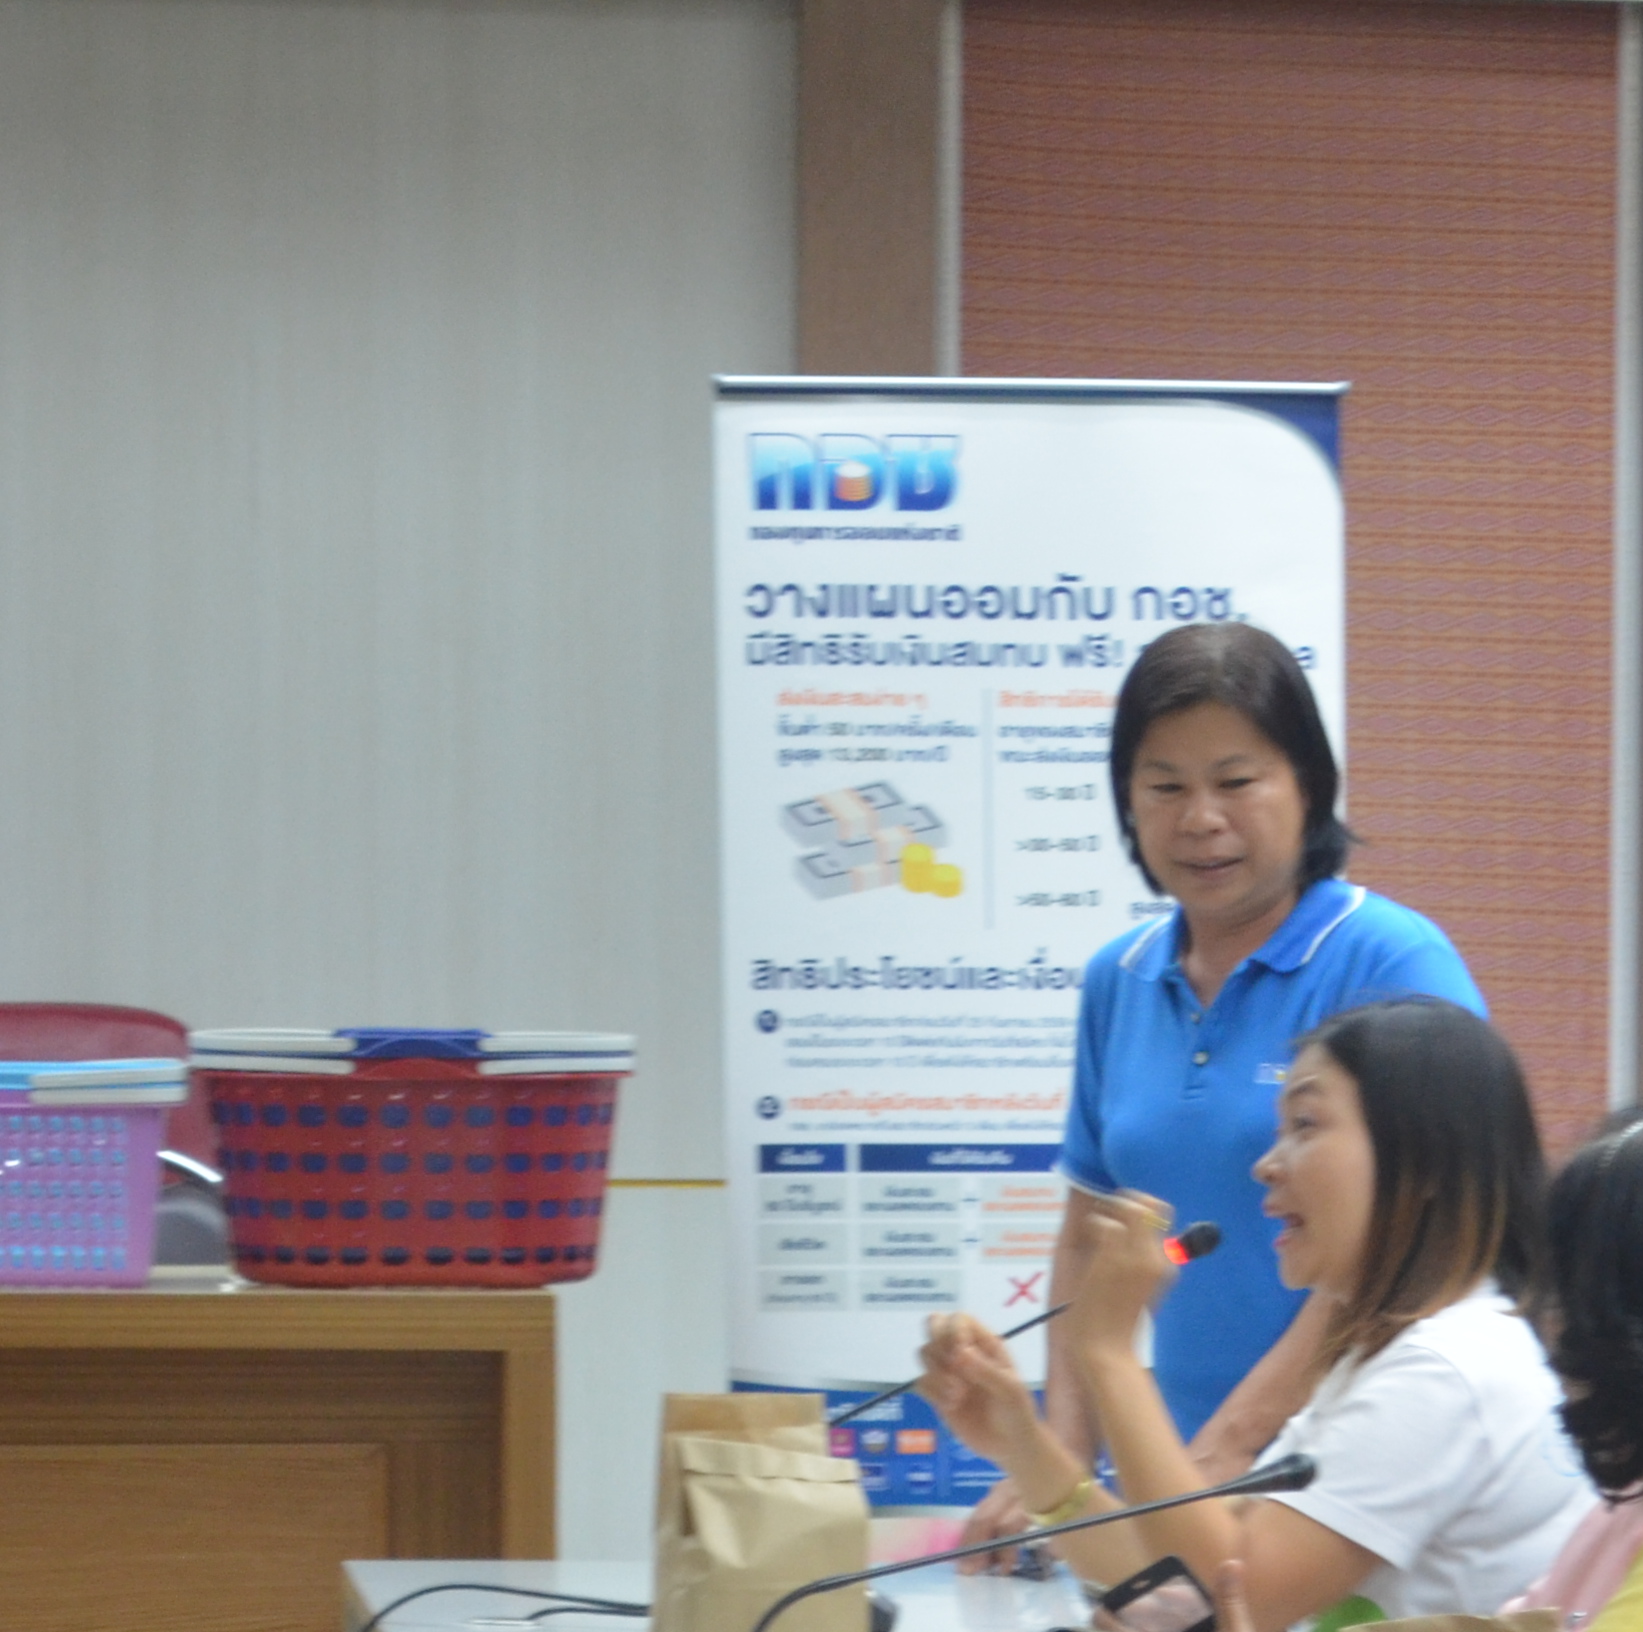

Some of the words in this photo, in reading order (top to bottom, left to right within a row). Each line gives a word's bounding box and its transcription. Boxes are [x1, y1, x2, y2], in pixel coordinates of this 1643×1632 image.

[745, 573, 1115, 620] วางแผนออมกับ
[1132, 586, 1248, 621] กอช.
